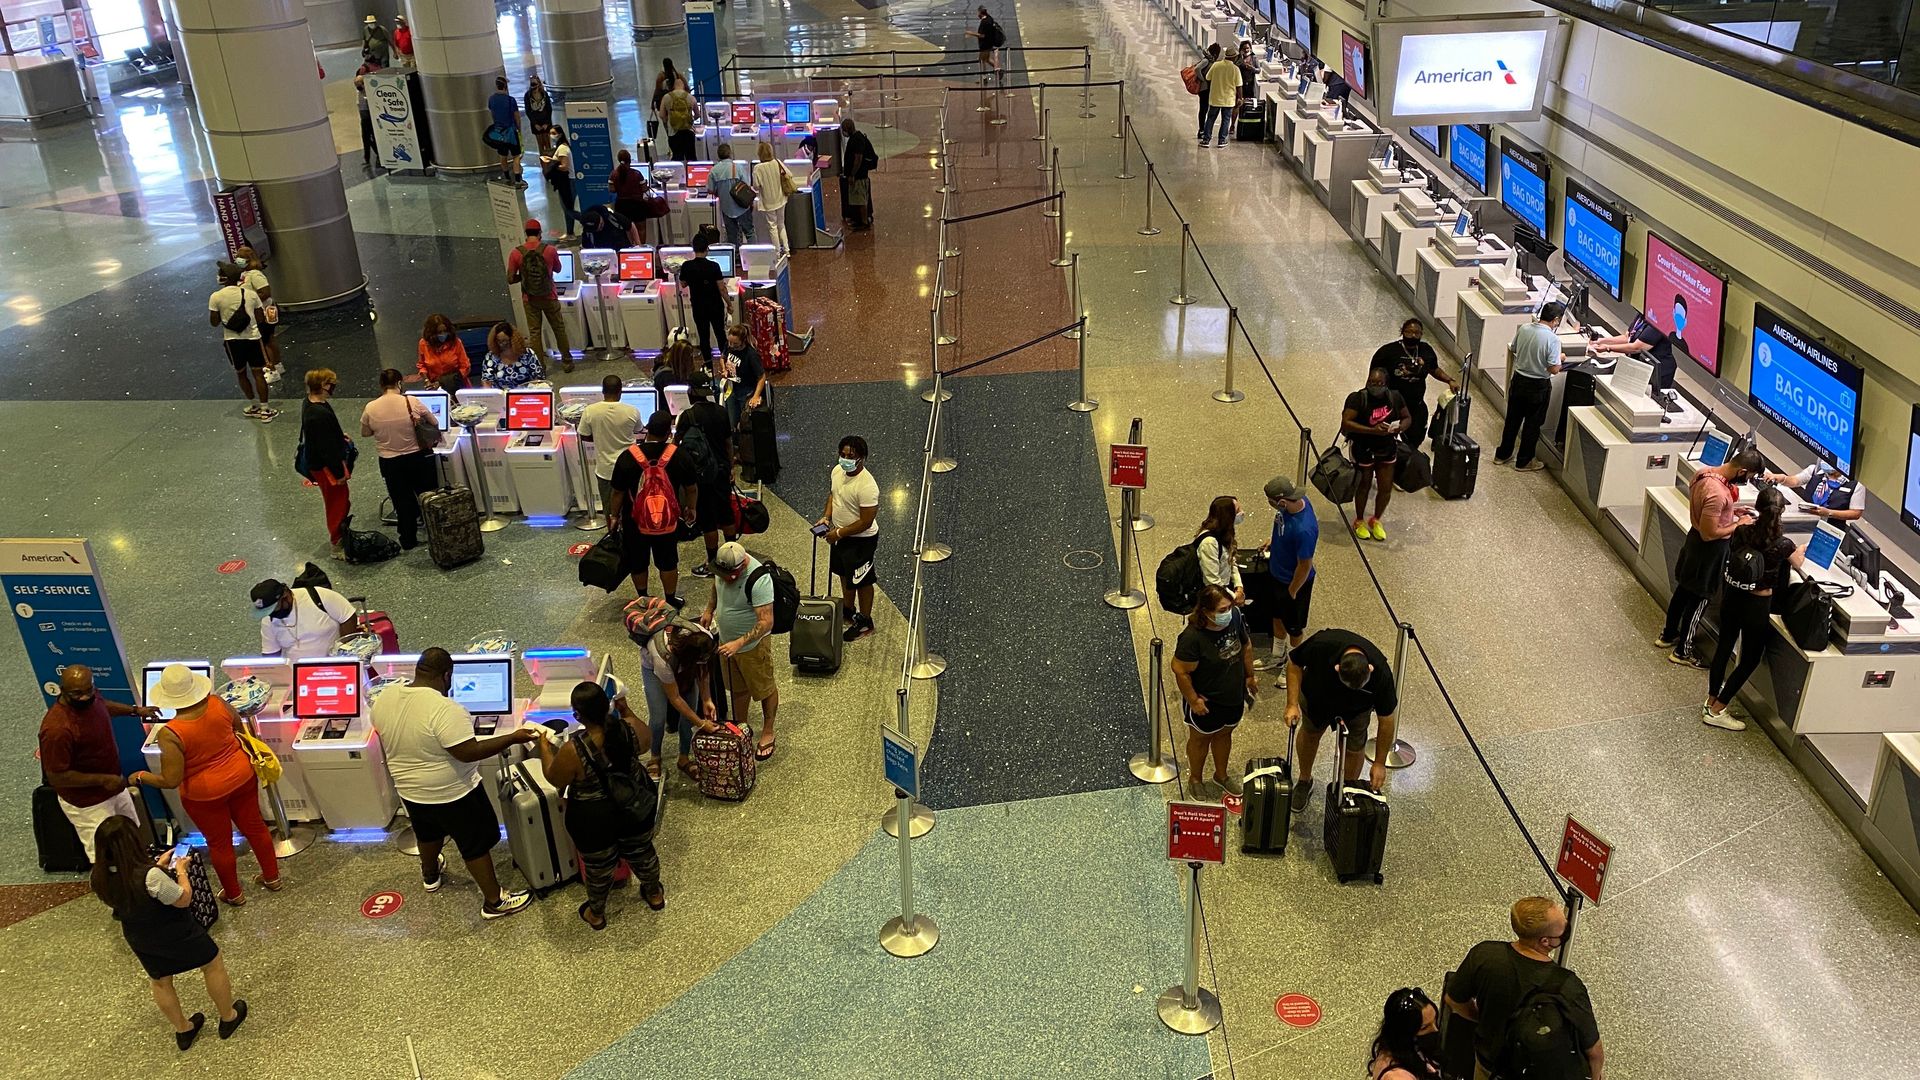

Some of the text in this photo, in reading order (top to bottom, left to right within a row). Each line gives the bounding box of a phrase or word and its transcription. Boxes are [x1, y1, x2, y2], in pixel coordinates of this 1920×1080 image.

[1414, 68, 1493, 84] American
[376, 90, 397, 98] Clean
[388, 98, 404, 106] Safe
[1459, 142, 1469, 160] BAG
[1469, 149, 1484, 169] DROP
[1512, 181, 1525, 202] BAG
[1525, 191, 1544, 214] DROP
[1576, 191, 1613, 222] AMERICAN AIRLINES
[217, 198, 229, 222] HAND
[228, 197, 238, 220] HAND
[1577, 229, 1594, 253] BAG
[1595, 243, 1619, 269] DROP
[1658, 253, 1671, 269] Cover
[1671, 262, 1682, 277] Your
[1682, 270, 1697, 287] Poker
[1697, 280, 1711, 296] Face!
[1762, 351, 1767, 364] 2
[1772, 323, 1838, 373] AMERICAN AIRLINES
[727, 352, 741, 367] VIVA
[1775, 372, 1849, 437] BAG DROP
[1757, 400, 1772, 416] THANK
[1772, 410, 1781, 423] YOU
[1781, 418, 1792, 431] FOR
[1791, 425, 1809, 443] FLYING
[1808, 437, 1822, 453] WITH
[21, 553, 65, 563] American
[854, 560, 871, 578] NIKE
[13, 585, 91, 595] SELF-SERVICE
[22, 608, 28, 616] 1
[50, 686, 57, 694] 2
[369, 895, 393, 914] 6ft
